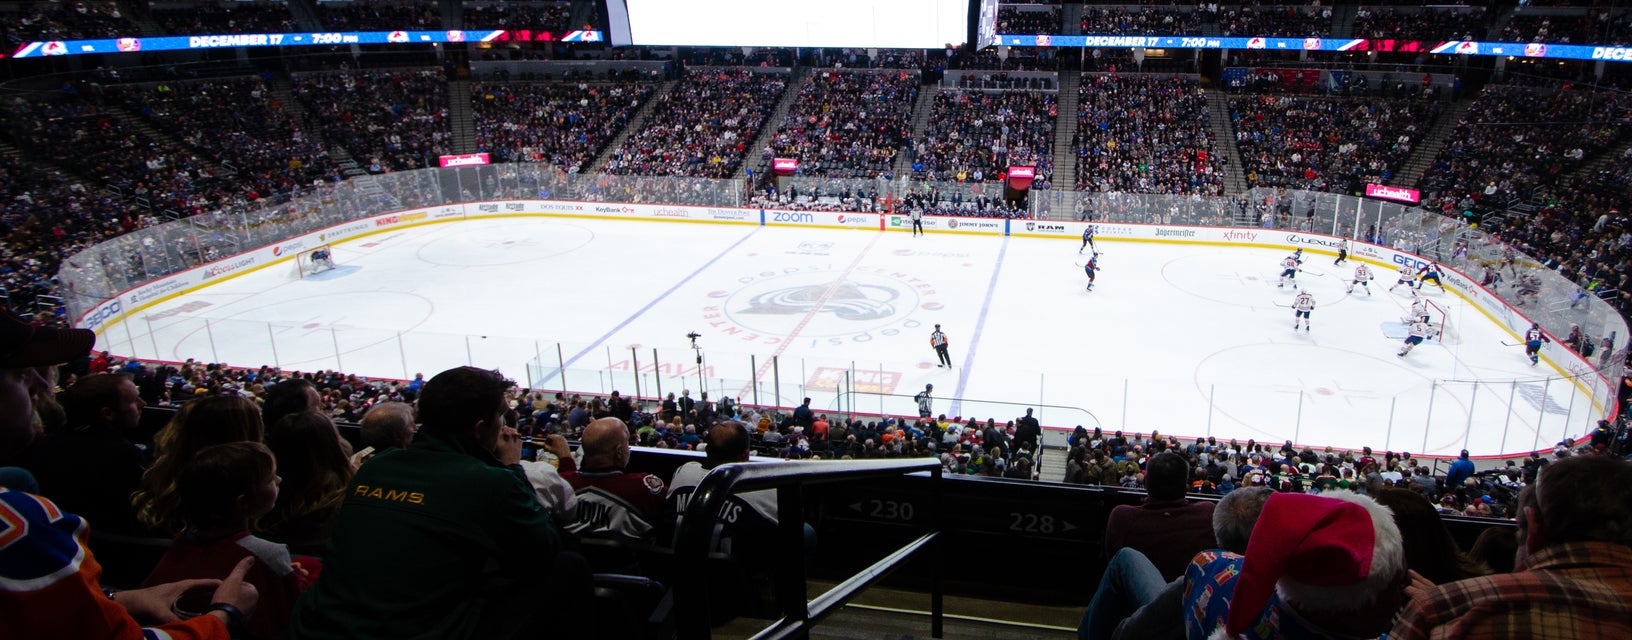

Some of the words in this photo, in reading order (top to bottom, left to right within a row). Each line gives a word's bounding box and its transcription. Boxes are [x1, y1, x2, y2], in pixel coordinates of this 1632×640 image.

[189, 34, 268, 48] DECEMBER
[268, 34, 284, 45] 17
[311, 33, 342, 44] 7:00
[342, 35, 359, 43] PM
[1085, 36, 1146, 47] DECEMBER
[1147, 37, 1159, 47] 17
[1181, 38, 1206, 47] 7:00
[1591, 46, 1632, 60] DECE
[1373, 187, 1412, 200] uchealth
[595, 206, 620, 214] KeyBank
[654, 209, 689, 217] uchealth
[773, 212, 813, 223] zoom
[847, 216, 867, 224] pepsi
[1223, 230, 1257, 242] xfinity
[210, 263, 235, 277] Coors
[234, 256, 255, 269] LIGHT
[1300, 297, 1310, 305] 27
[83, 301, 121, 329] GEICO
[1416, 324, 1422, 332] 5
[354, 484, 424, 505] RAMS
[869, 499, 914, 521] 230
[1009, 512, 1054, 534] 228
